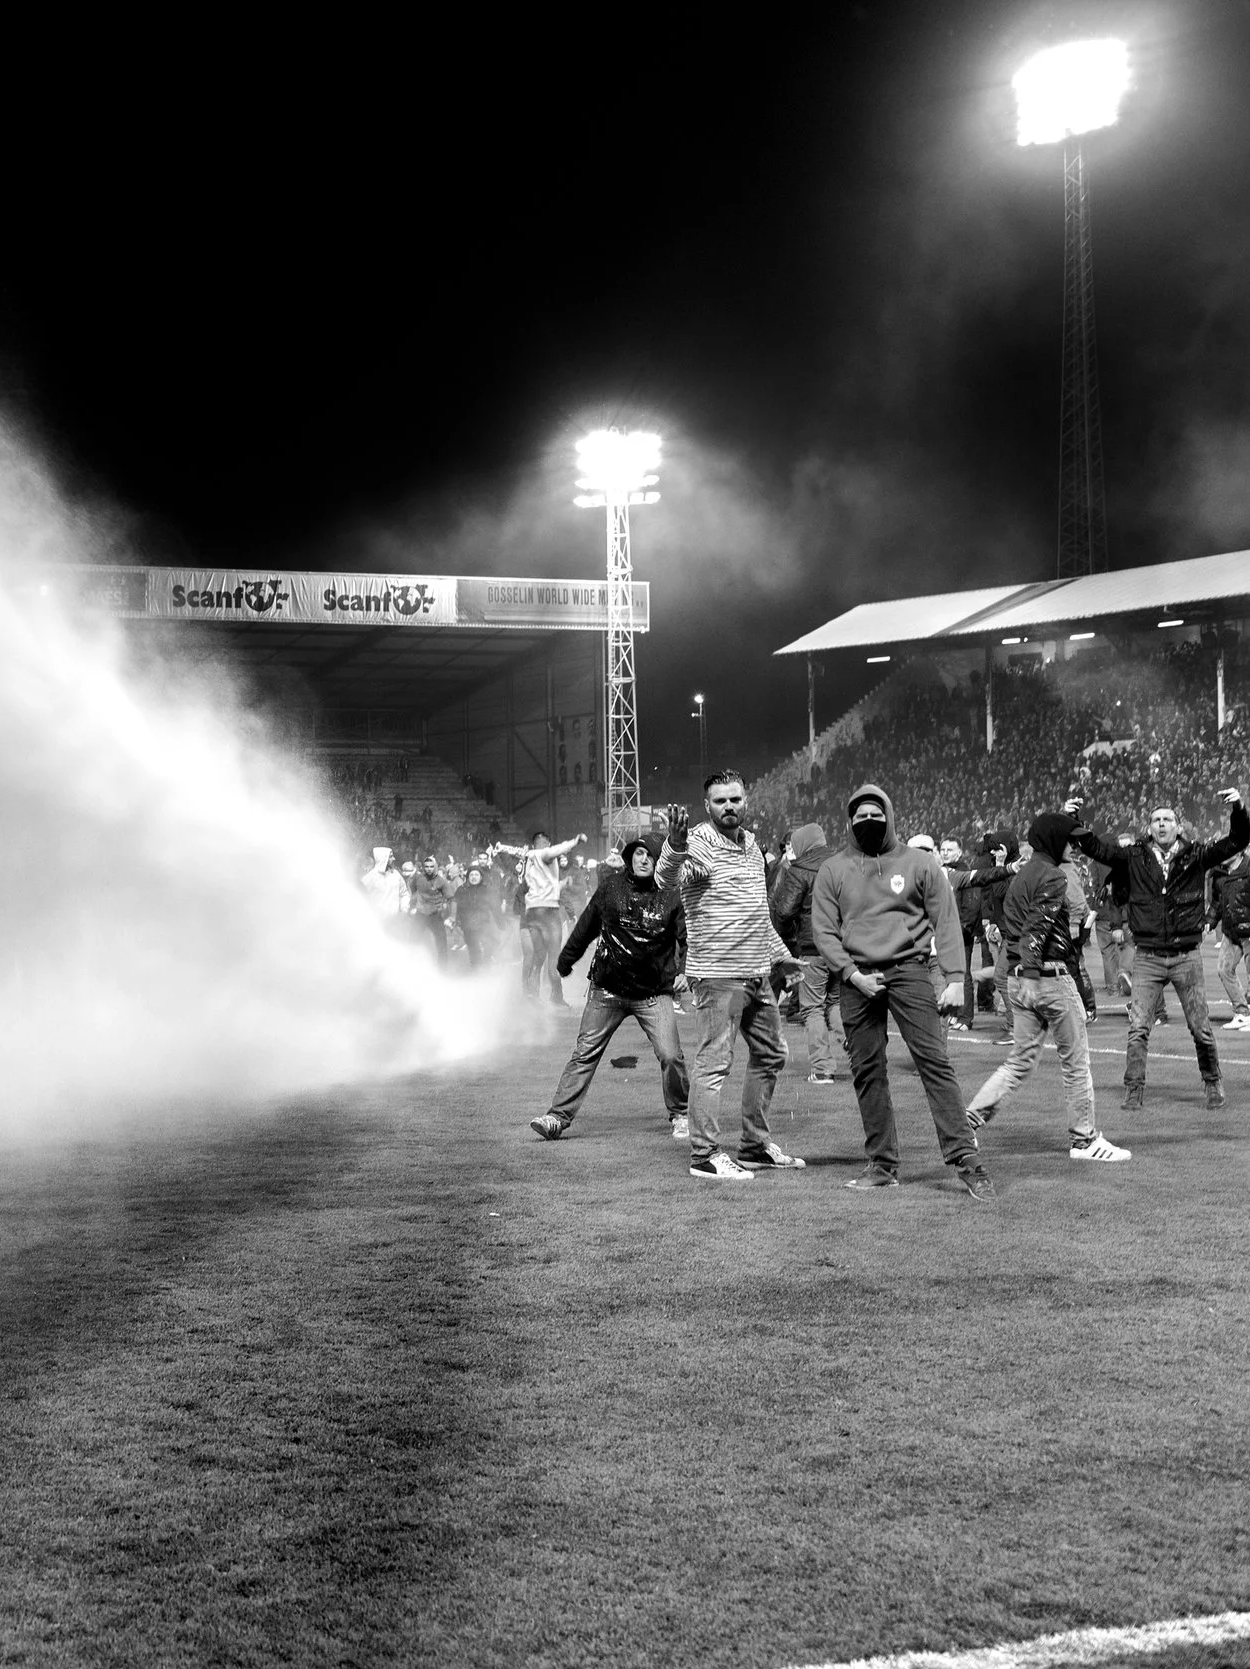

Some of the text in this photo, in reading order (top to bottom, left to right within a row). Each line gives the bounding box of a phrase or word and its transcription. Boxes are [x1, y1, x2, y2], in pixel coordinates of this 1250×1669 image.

[487, 586, 534, 604] GOSSELIN
[537, 587, 569, 605] WORLD
[572, 588, 595, 606] WIDE
